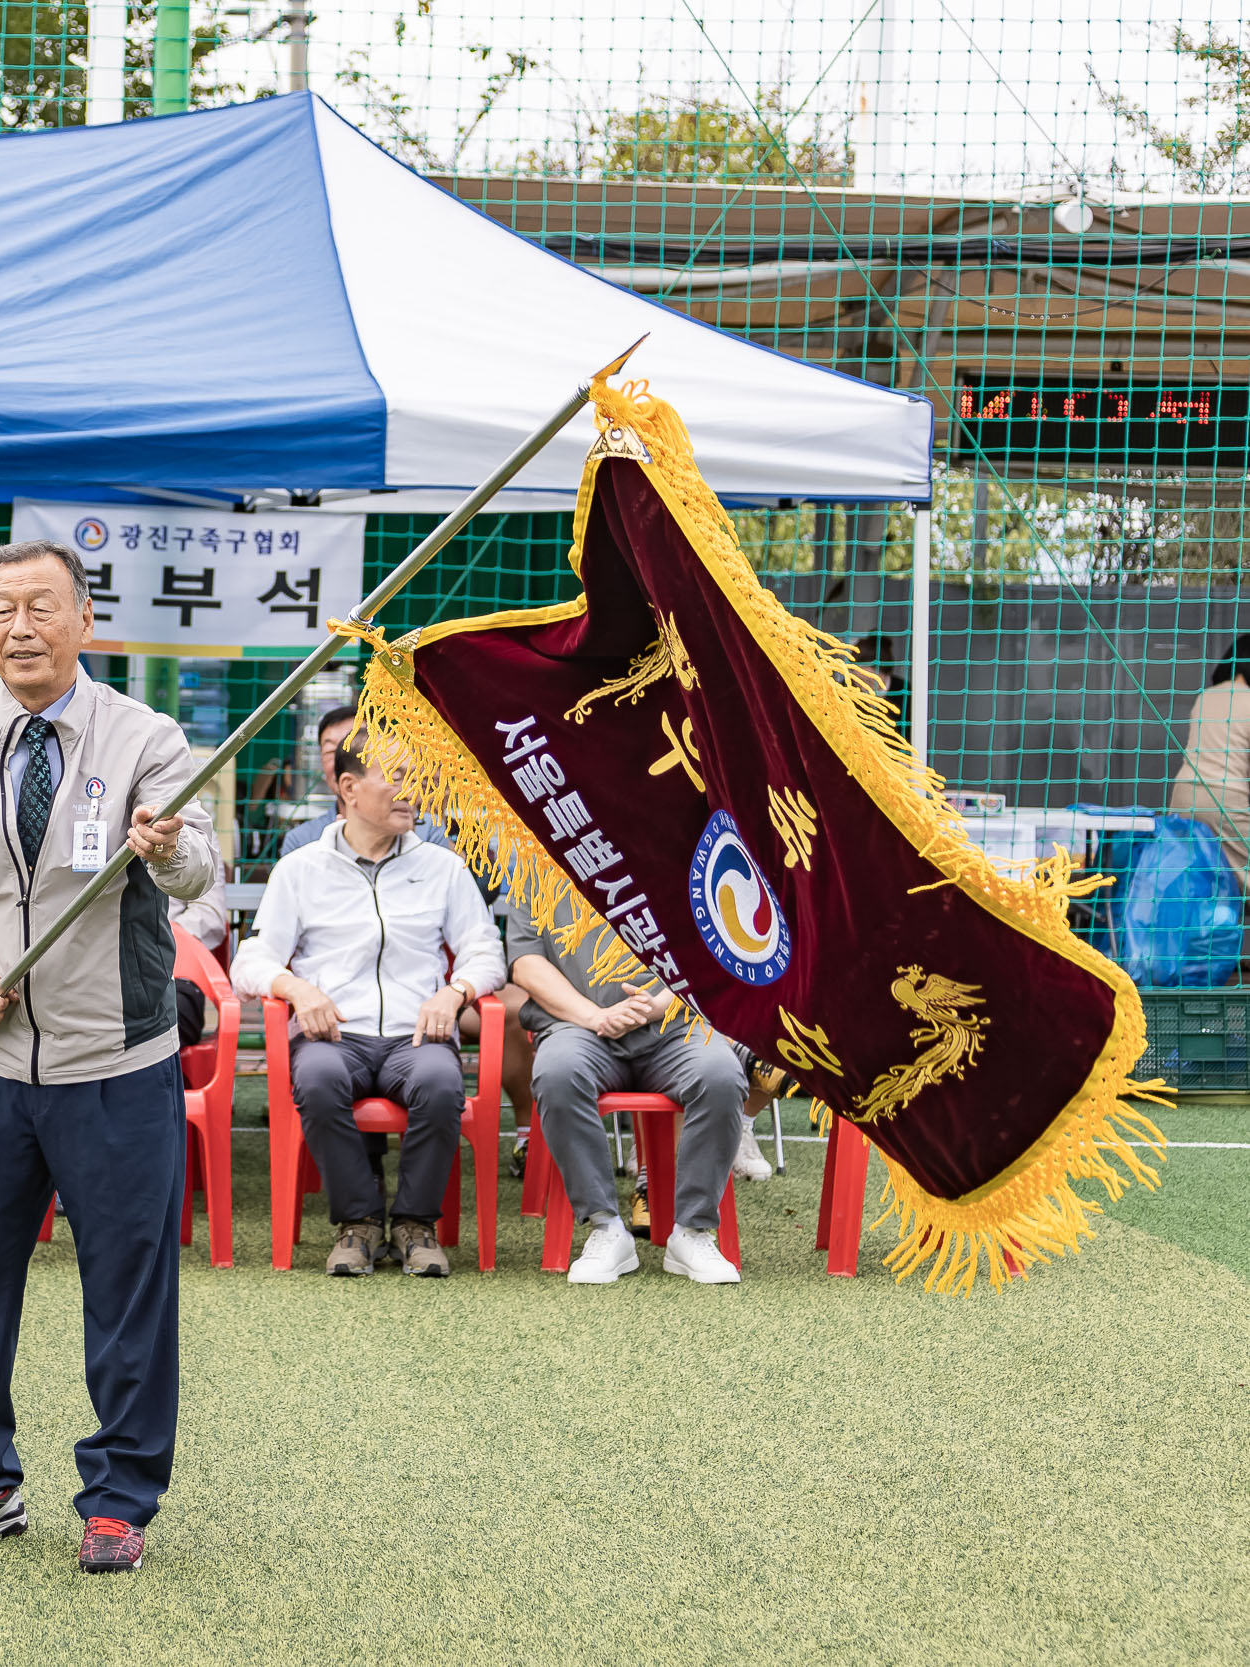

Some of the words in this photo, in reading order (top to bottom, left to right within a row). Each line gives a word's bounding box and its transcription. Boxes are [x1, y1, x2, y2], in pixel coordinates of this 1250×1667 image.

[120, 524, 300, 555] 광진구족구협회
[767, 783, 817, 872] 축
[692, 835, 756, 982] GWANGJIN-GU
